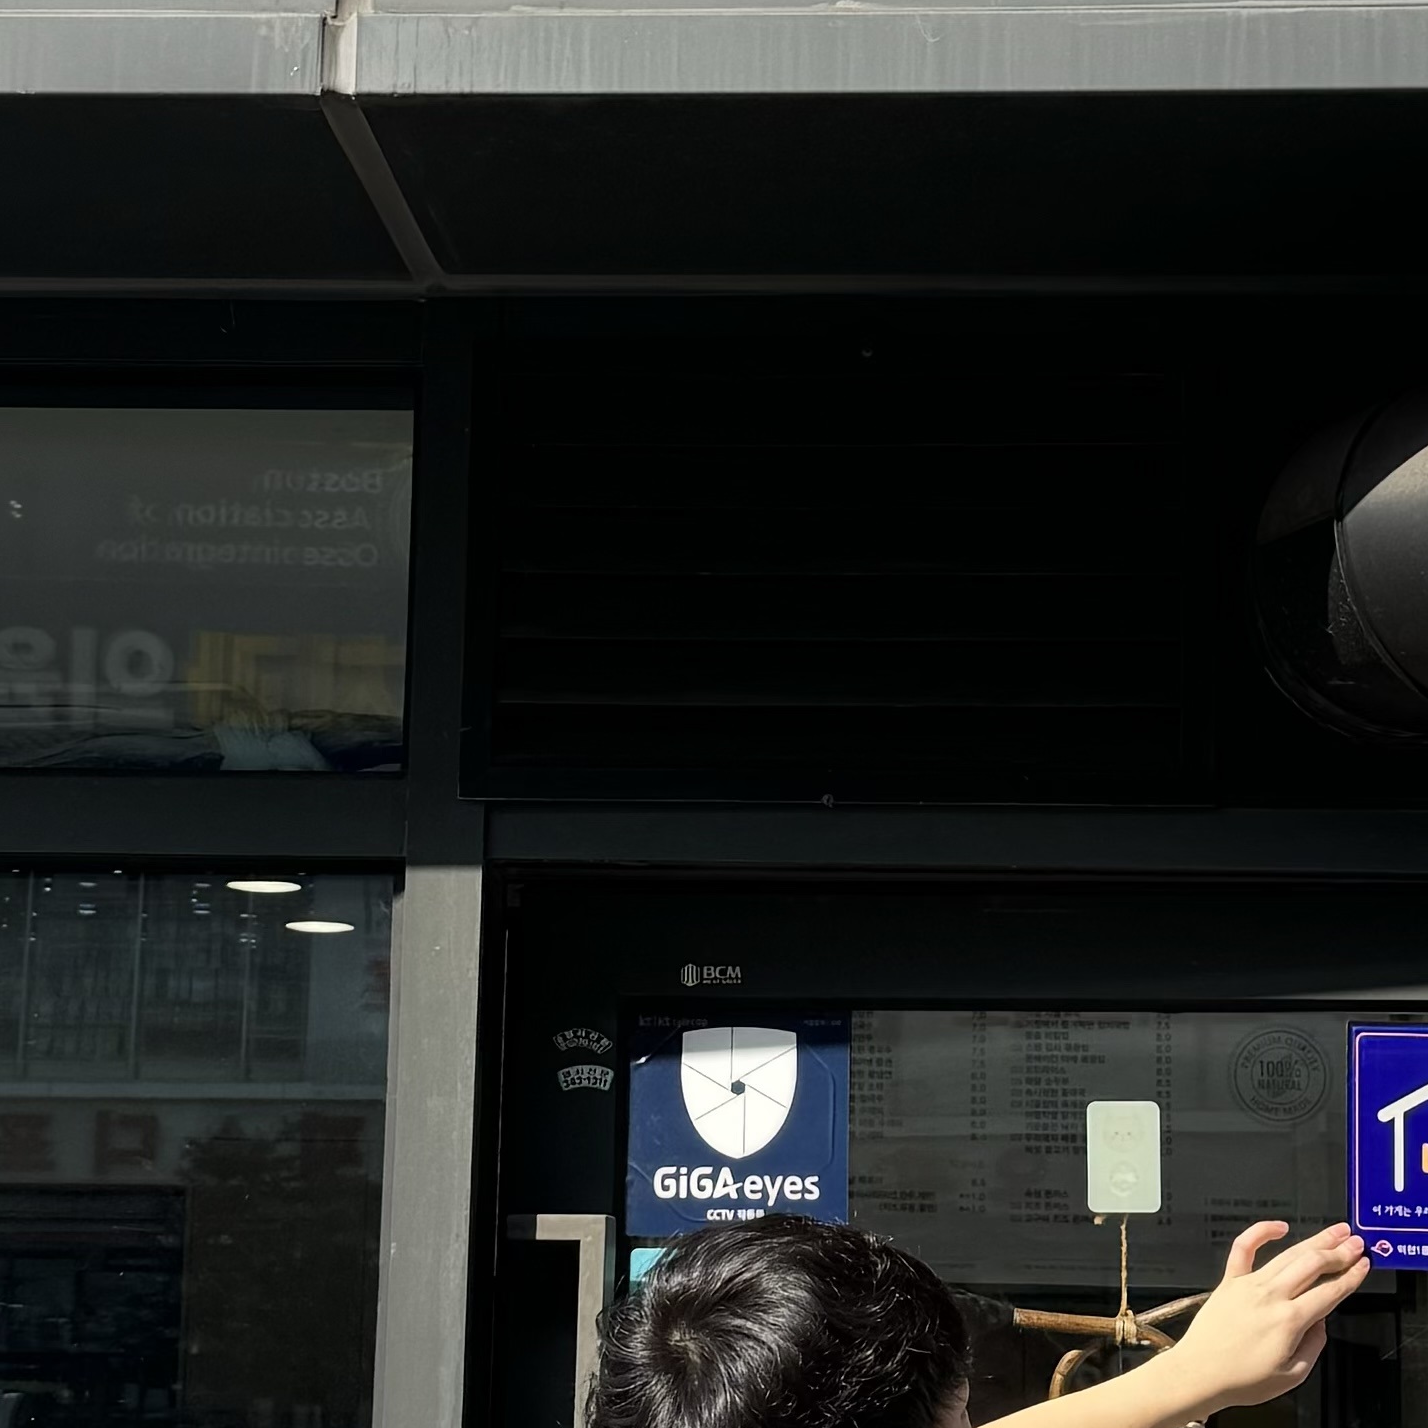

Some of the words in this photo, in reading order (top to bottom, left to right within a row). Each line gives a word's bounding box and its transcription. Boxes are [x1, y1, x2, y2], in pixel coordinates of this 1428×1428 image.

[702, 965, 742, 979] BCM
[1259, 1060, 1302, 1078] 100%
[1257, 1078, 1303, 1091] NATURAL
[706, 1209, 734, 1221] CCTV
